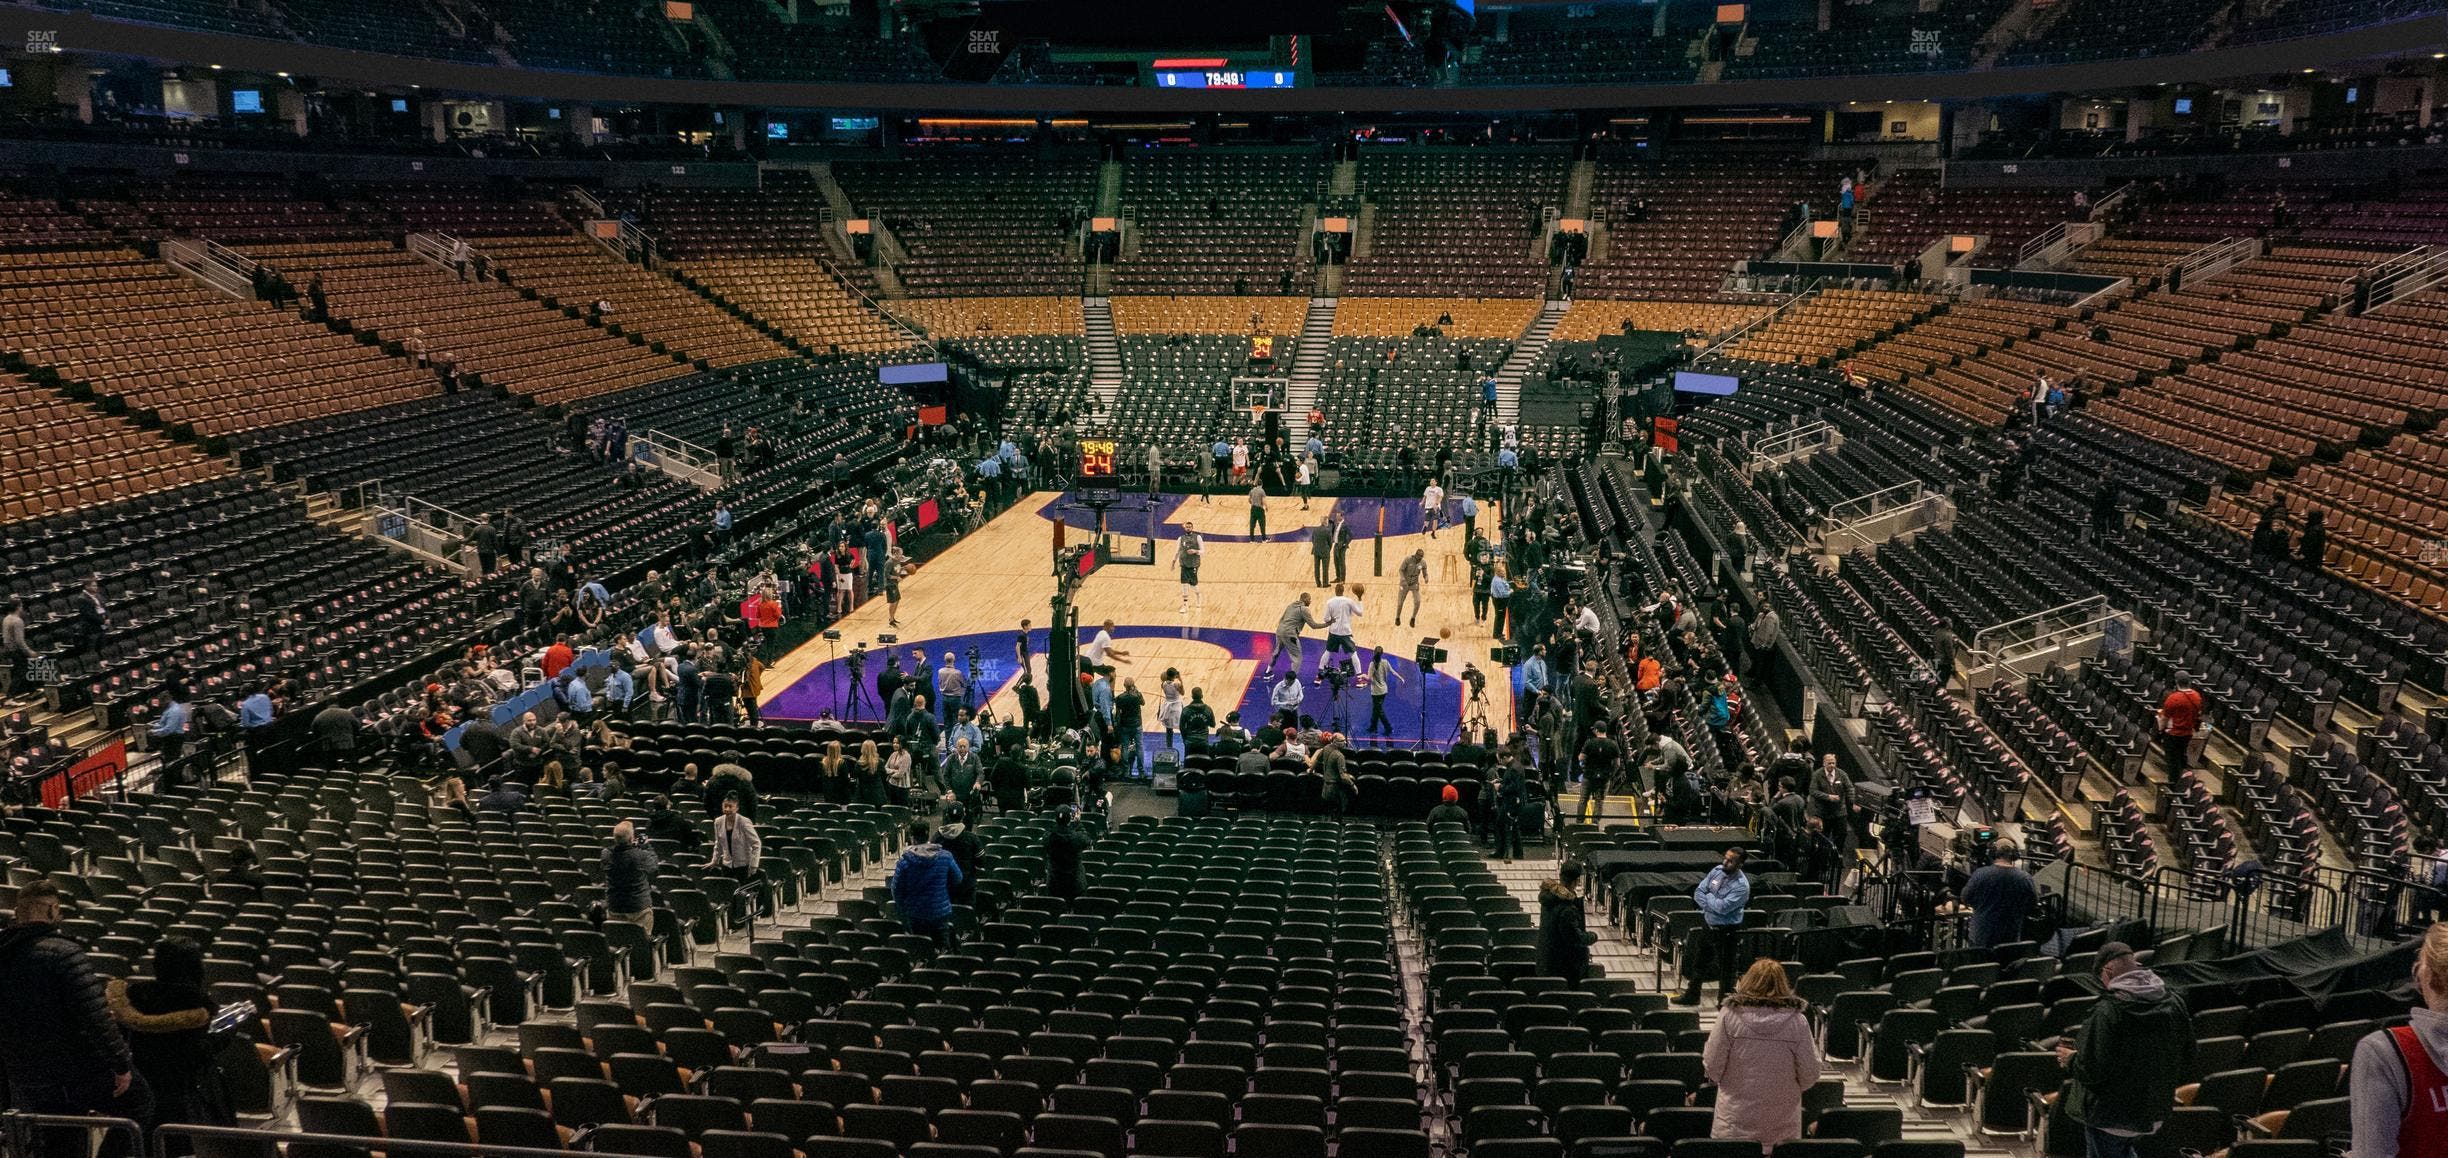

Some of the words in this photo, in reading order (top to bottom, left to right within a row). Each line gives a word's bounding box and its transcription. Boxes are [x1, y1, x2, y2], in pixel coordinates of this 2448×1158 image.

[1167, 72, 1176, 86] 0
[1274, 73, 1283, 85] 0
[671, 165, 686, 175] 122
[1253, 345, 1270, 358] 24
[1084, 454, 1111, 475] 24
